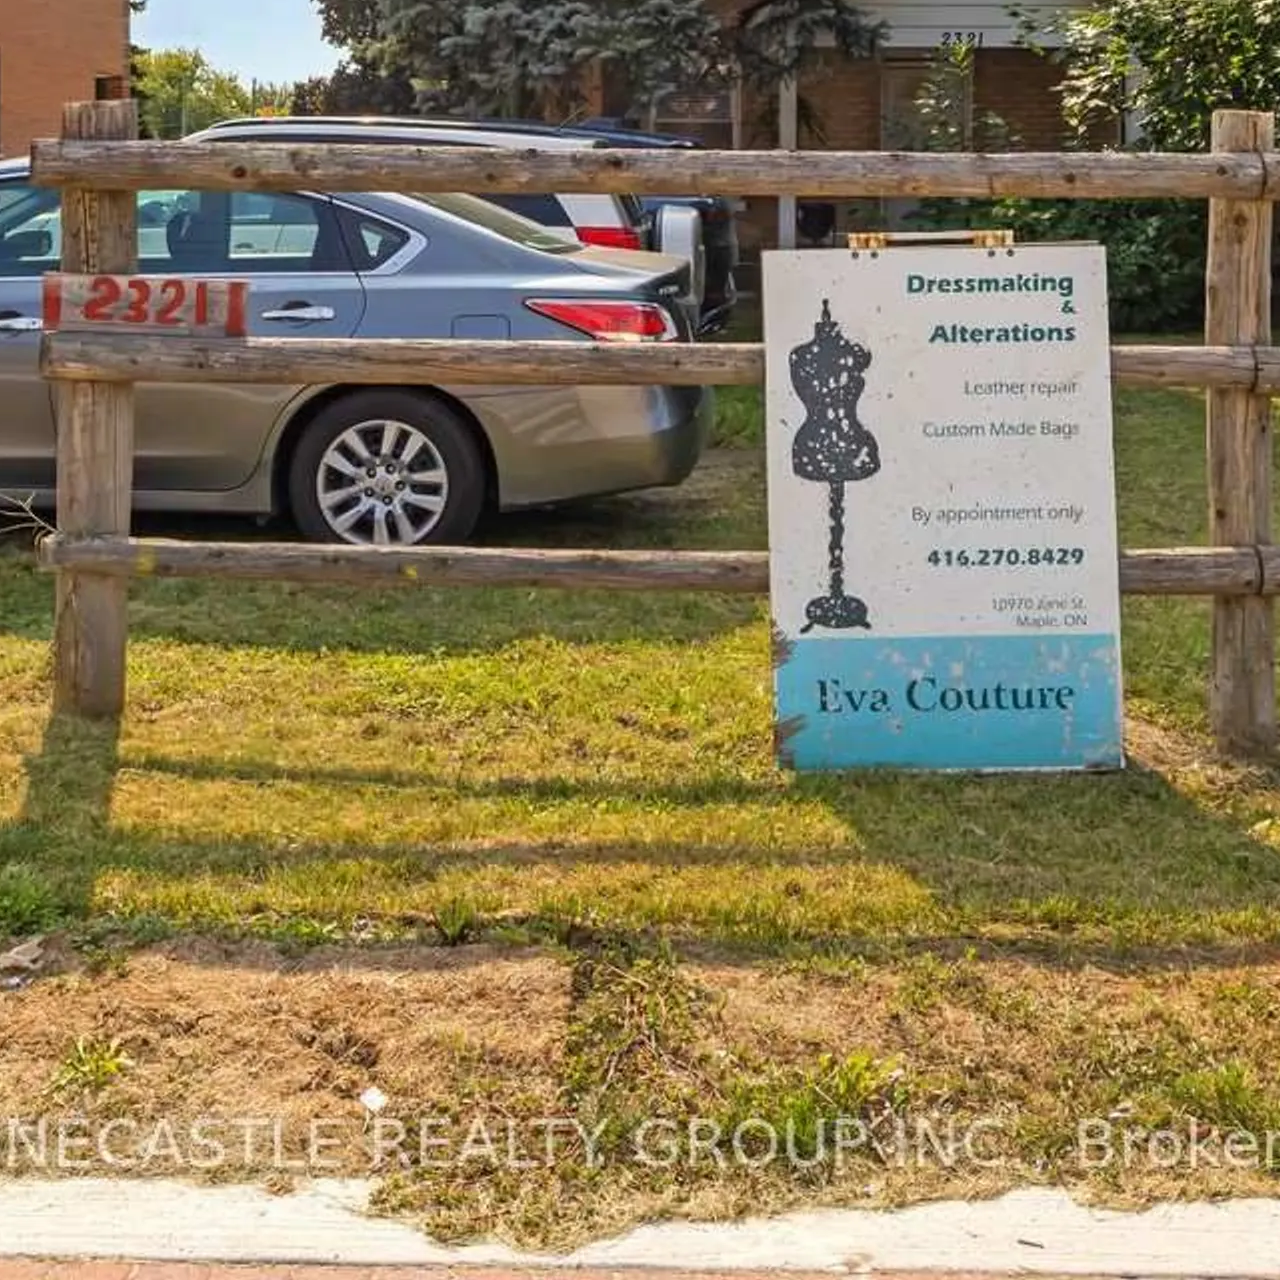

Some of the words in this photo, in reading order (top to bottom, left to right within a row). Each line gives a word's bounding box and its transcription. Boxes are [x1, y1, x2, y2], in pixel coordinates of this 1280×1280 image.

[942, 31, 983, 47] 2321
[906, 273, 1074, 298] Dressmaking
[81, 276, 208, 326] 2321
[1060, 300, 1076, 314] &
[928, 323, 1076, 344] Alterations
[964, 381, 1025, 396] Leather
[1030, 381, 1078, 398] repair
[922, 422, 985, 438] Custom
[990, 421, 1037, 436] Made
[1040, 420, 1080, 440] Bags
[912, 506, 931, 525] By
[936, 503, 1042, 524] appointment
[1047, 504, 1084, 523] only
[927, 548, 1084, 567] 416.270.8429
[1064, 613, 1087, 626] ON
[817, 678, 891, 713] Eva
[906, 676, 1075, 712] Couture
